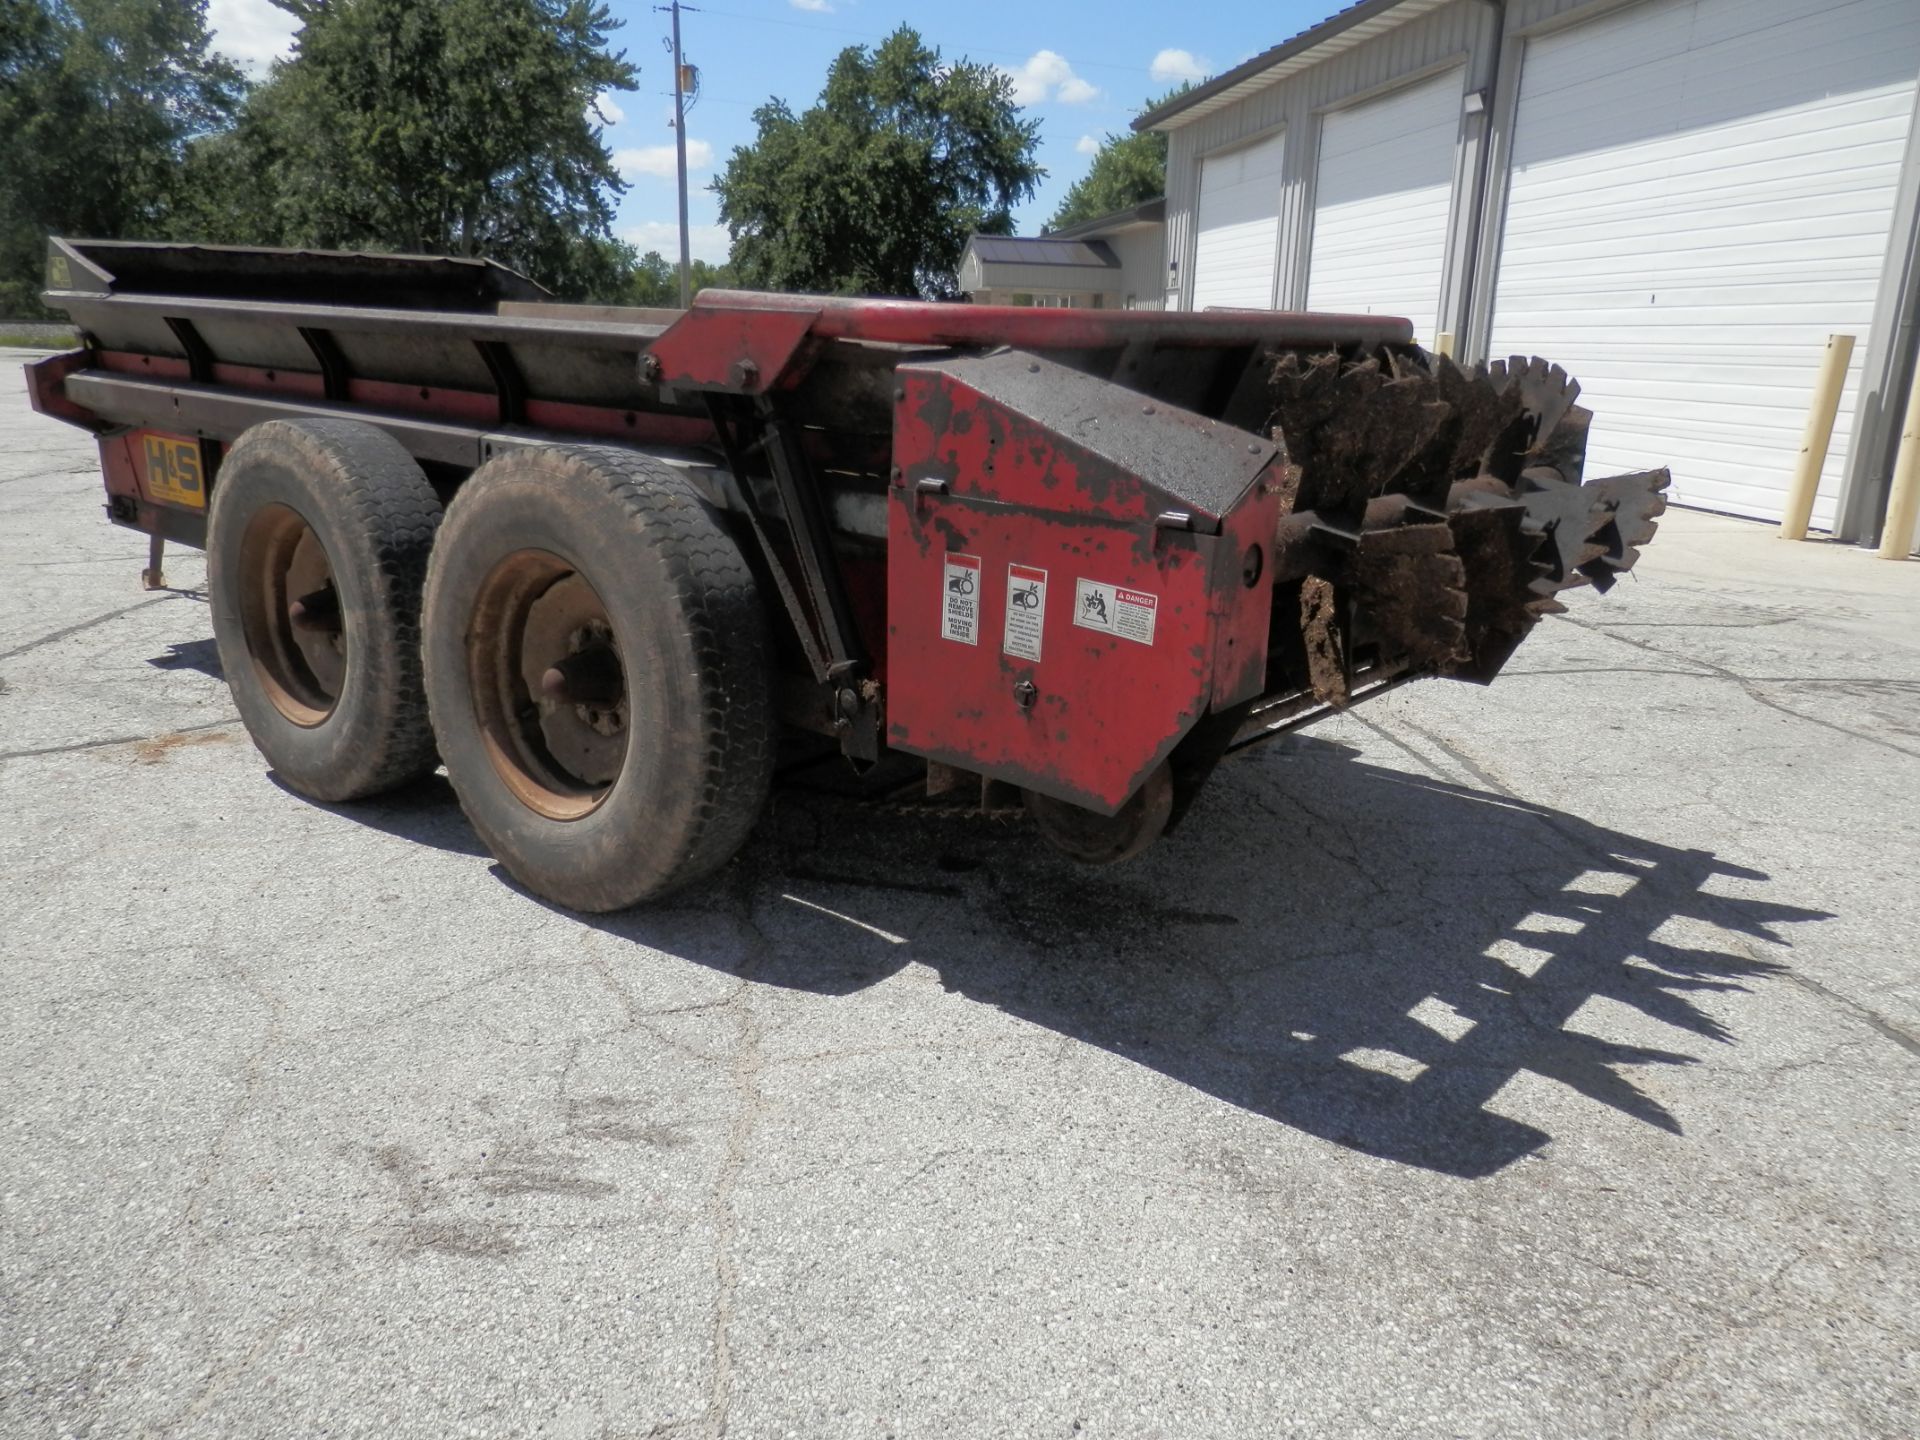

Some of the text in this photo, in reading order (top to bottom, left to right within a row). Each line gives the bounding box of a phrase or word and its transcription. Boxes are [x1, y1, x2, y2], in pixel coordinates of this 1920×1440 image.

[146, 438, 199, 491] H&S
[960, 599, 972, 607] NOT
[1125, 594, 1154, 606] DANGER
[948, 603, 973, 612] REMOVE
[948, 609, 973, 618] SHIELDS
[948, 617, 972, 627] MOVING
[950, 623, 970, 632] PARTS
[949, 629, 970, 639] INSIDE
